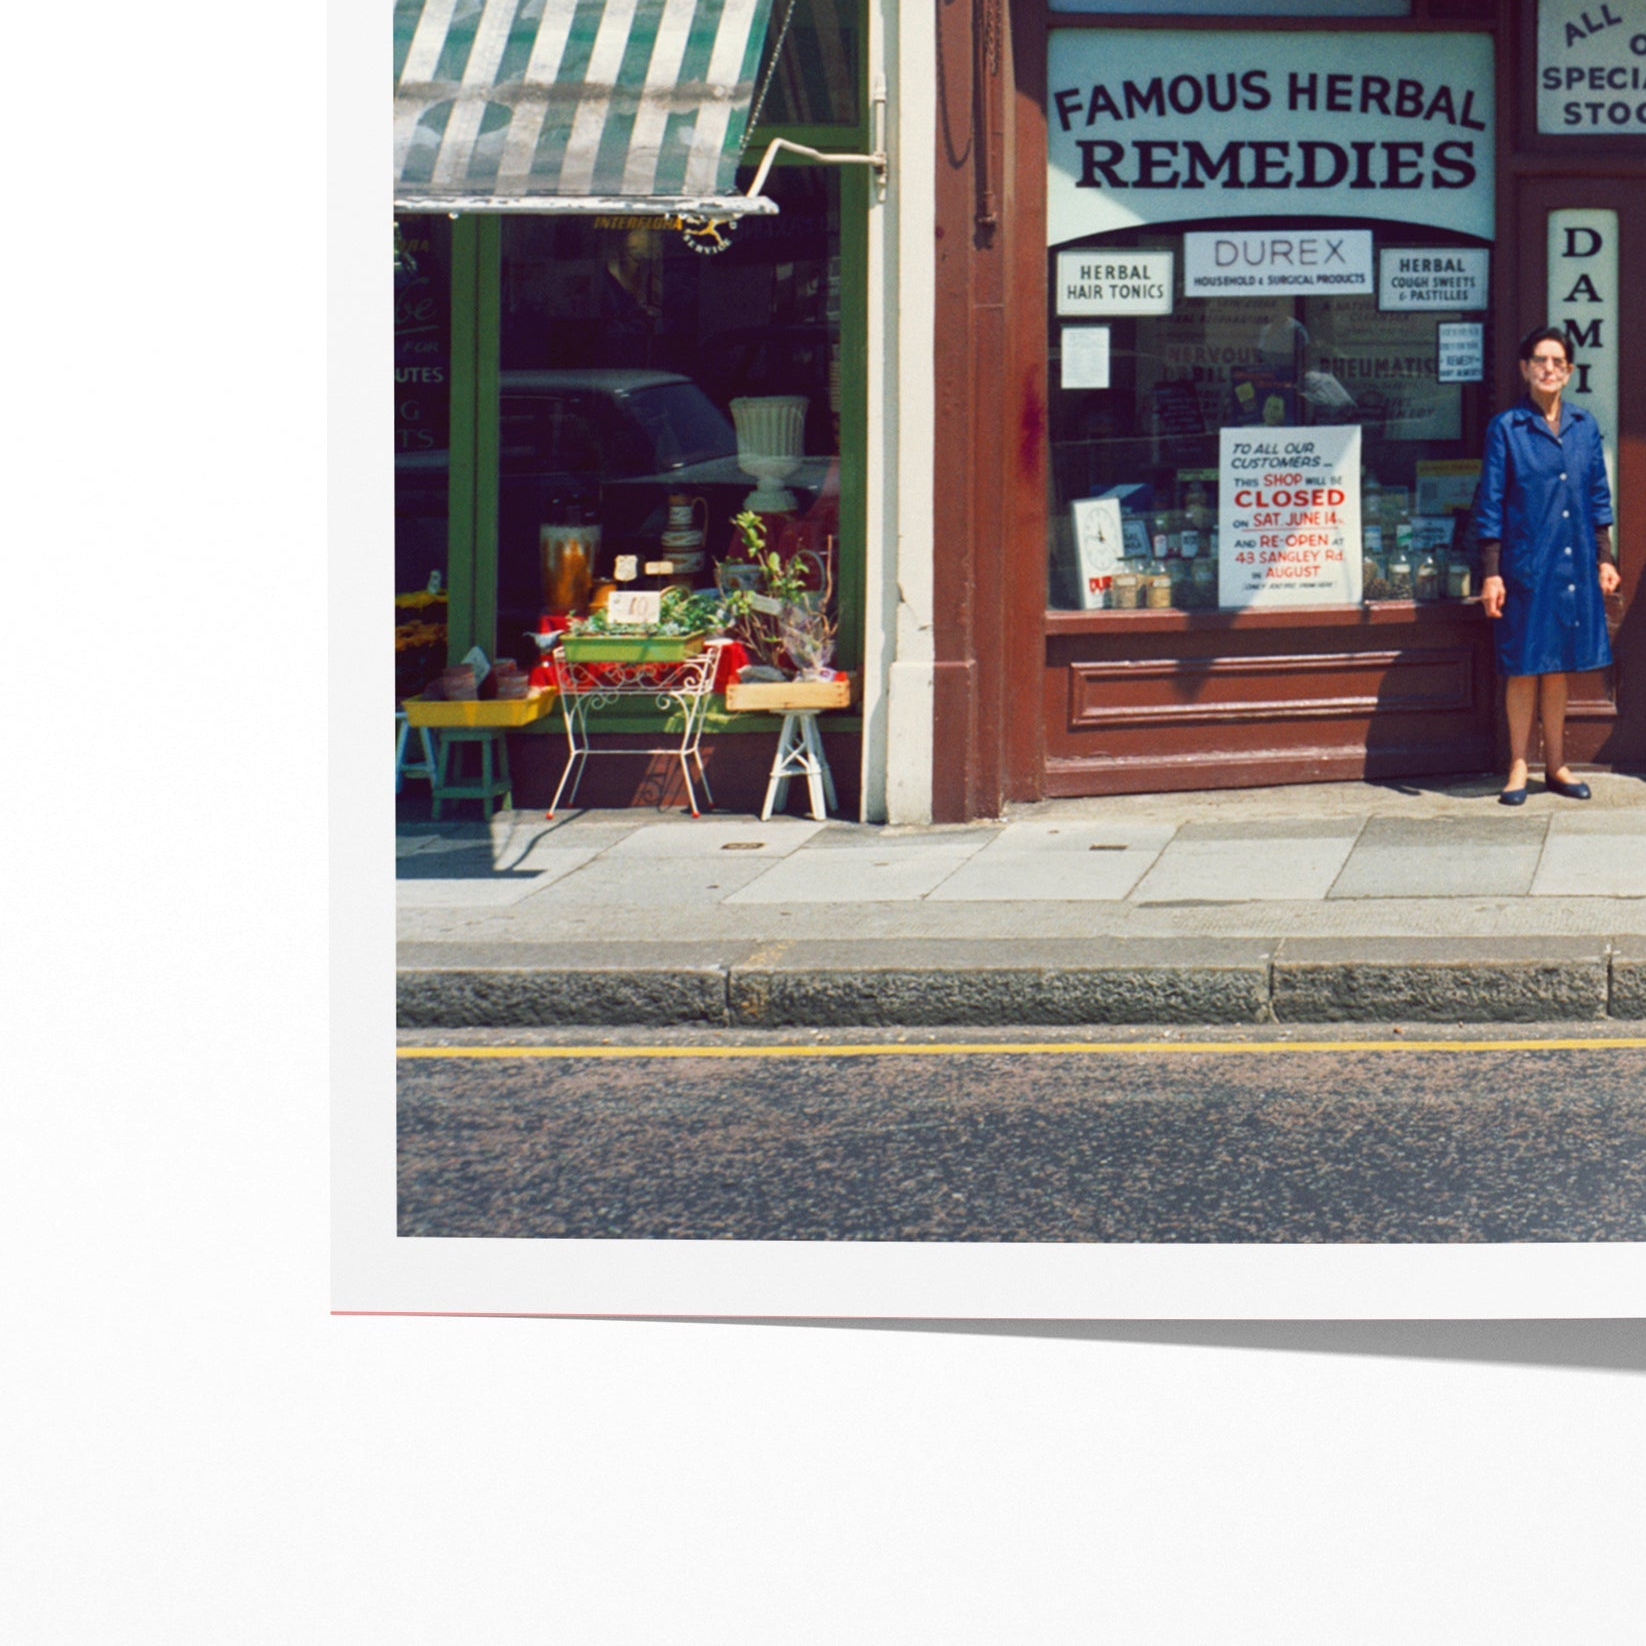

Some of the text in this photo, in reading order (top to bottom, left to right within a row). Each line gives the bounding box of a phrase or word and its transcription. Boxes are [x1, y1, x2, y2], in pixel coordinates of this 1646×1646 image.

[1564, 4, 1623, 49] ALL
[1053, 69, 1487, 132] FAMOUS HERBAL
[1074, 139, 1477, 189] REMEDIES
[594, 210, 683, 231] INTERFLORA
[1214, 238, 1347, 267] DUREX
[1080, 265, 1152, 281] HERBAL
[1400, 258, 1466, 273] HERBAL
[1194, 276, 1256, 287] HOUSEHOLD
[1267, 275, 1314, 286] SURGICAL
[1316, 273, 1366, 285] PRODUCTS
[1391, 276, 1476, 289] COUGH SWEETS
[1067, 284, 1164, 300] HAIR TONICS
[1410, 290, 1469, 302] PASTILLES
[1319, 356, 1438, 379] RHEUMATIS
[1233, 441, 1315, 455] TO ALL OUR
[1230, 455, 1321, 470] CUSTOMERS
[1234, 477, 1260, 488] THIS
[1263, 472, 1303, 488] SHOP
[1305, 476, 1327, 486] WILL
[1234, 488, 1346, 509] CLOSED
[1233, 519, 1249, 529] ON
[1285, 511, 1321, 527] JUNE
[1234, 534, 1344, 548] AND RE-OPEN AT
[1235, 551, 1255, 565] 43
[1259, 550, 1320, 564] SANGLEY
[1266, 565, 1321, 579] AUGUST
